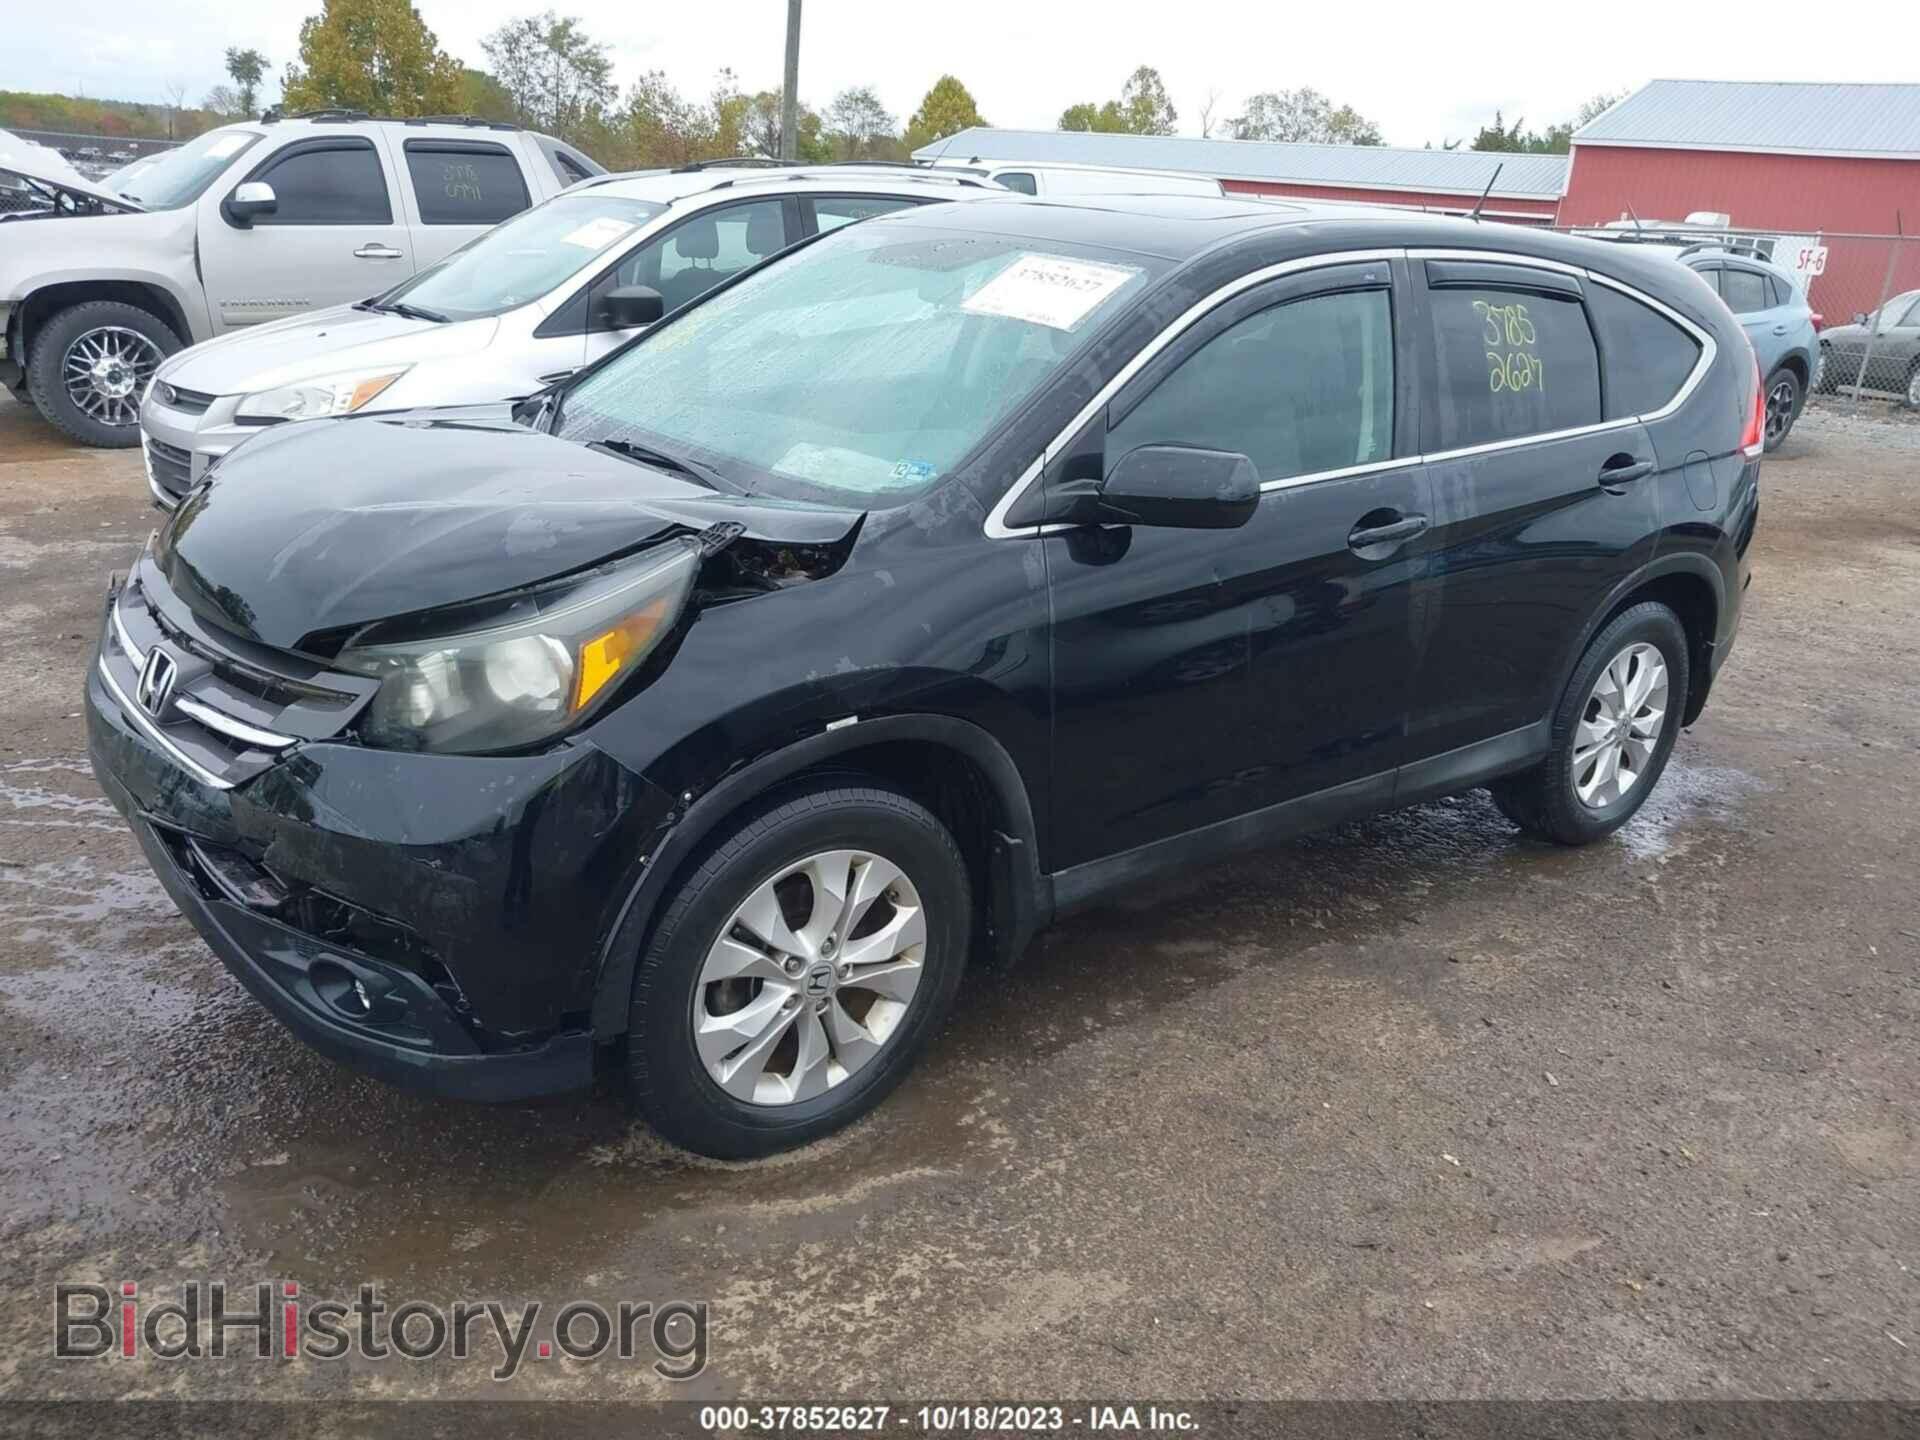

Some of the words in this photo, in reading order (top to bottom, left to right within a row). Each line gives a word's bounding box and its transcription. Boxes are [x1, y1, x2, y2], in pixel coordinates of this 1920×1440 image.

[1796, 248, 1825, 271] SF-6
[1472, 300, 1536, 346] 3785
[1486, 351, 1543, 392] 2627
